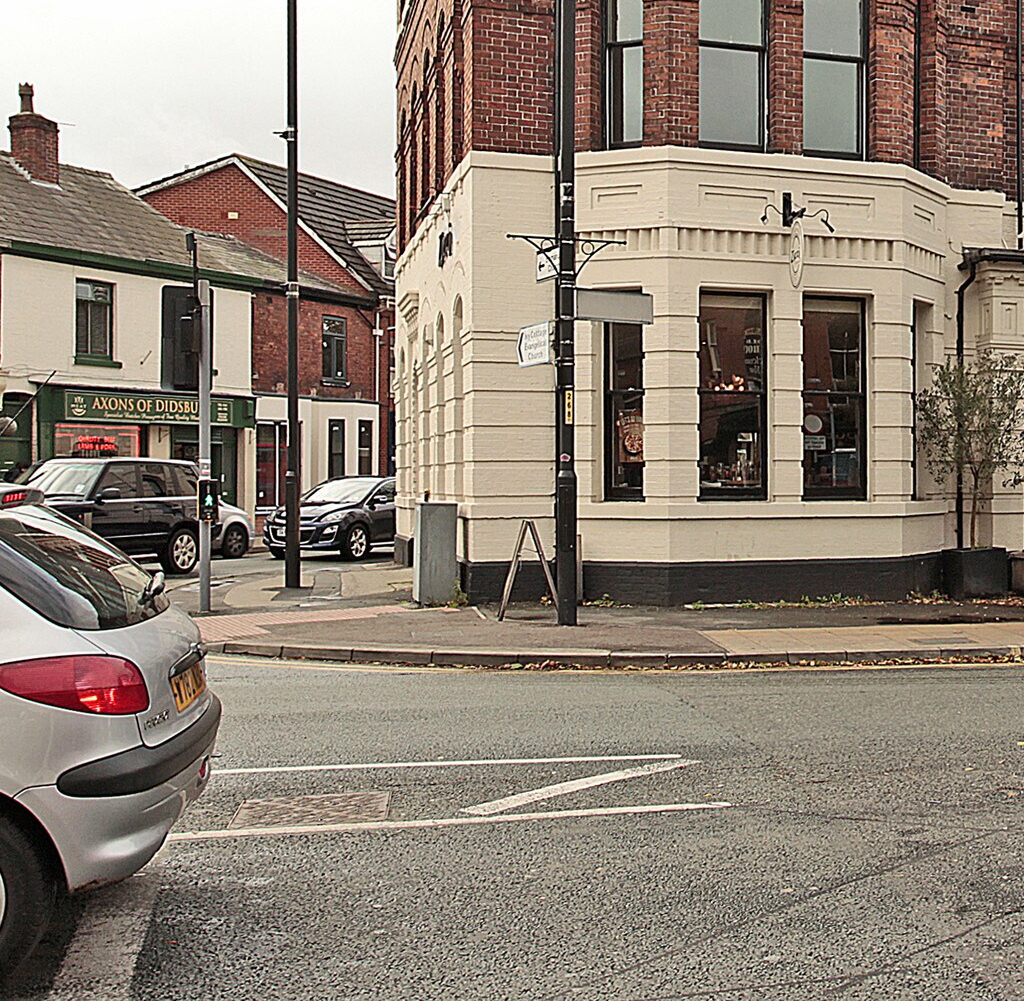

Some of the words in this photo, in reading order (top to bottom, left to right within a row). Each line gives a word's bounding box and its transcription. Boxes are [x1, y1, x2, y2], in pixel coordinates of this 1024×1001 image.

[92, 397, 134, 411] AXONS
[136, 399, 153, 412] OF
[156, 400, 199, 414] DIDSBU
